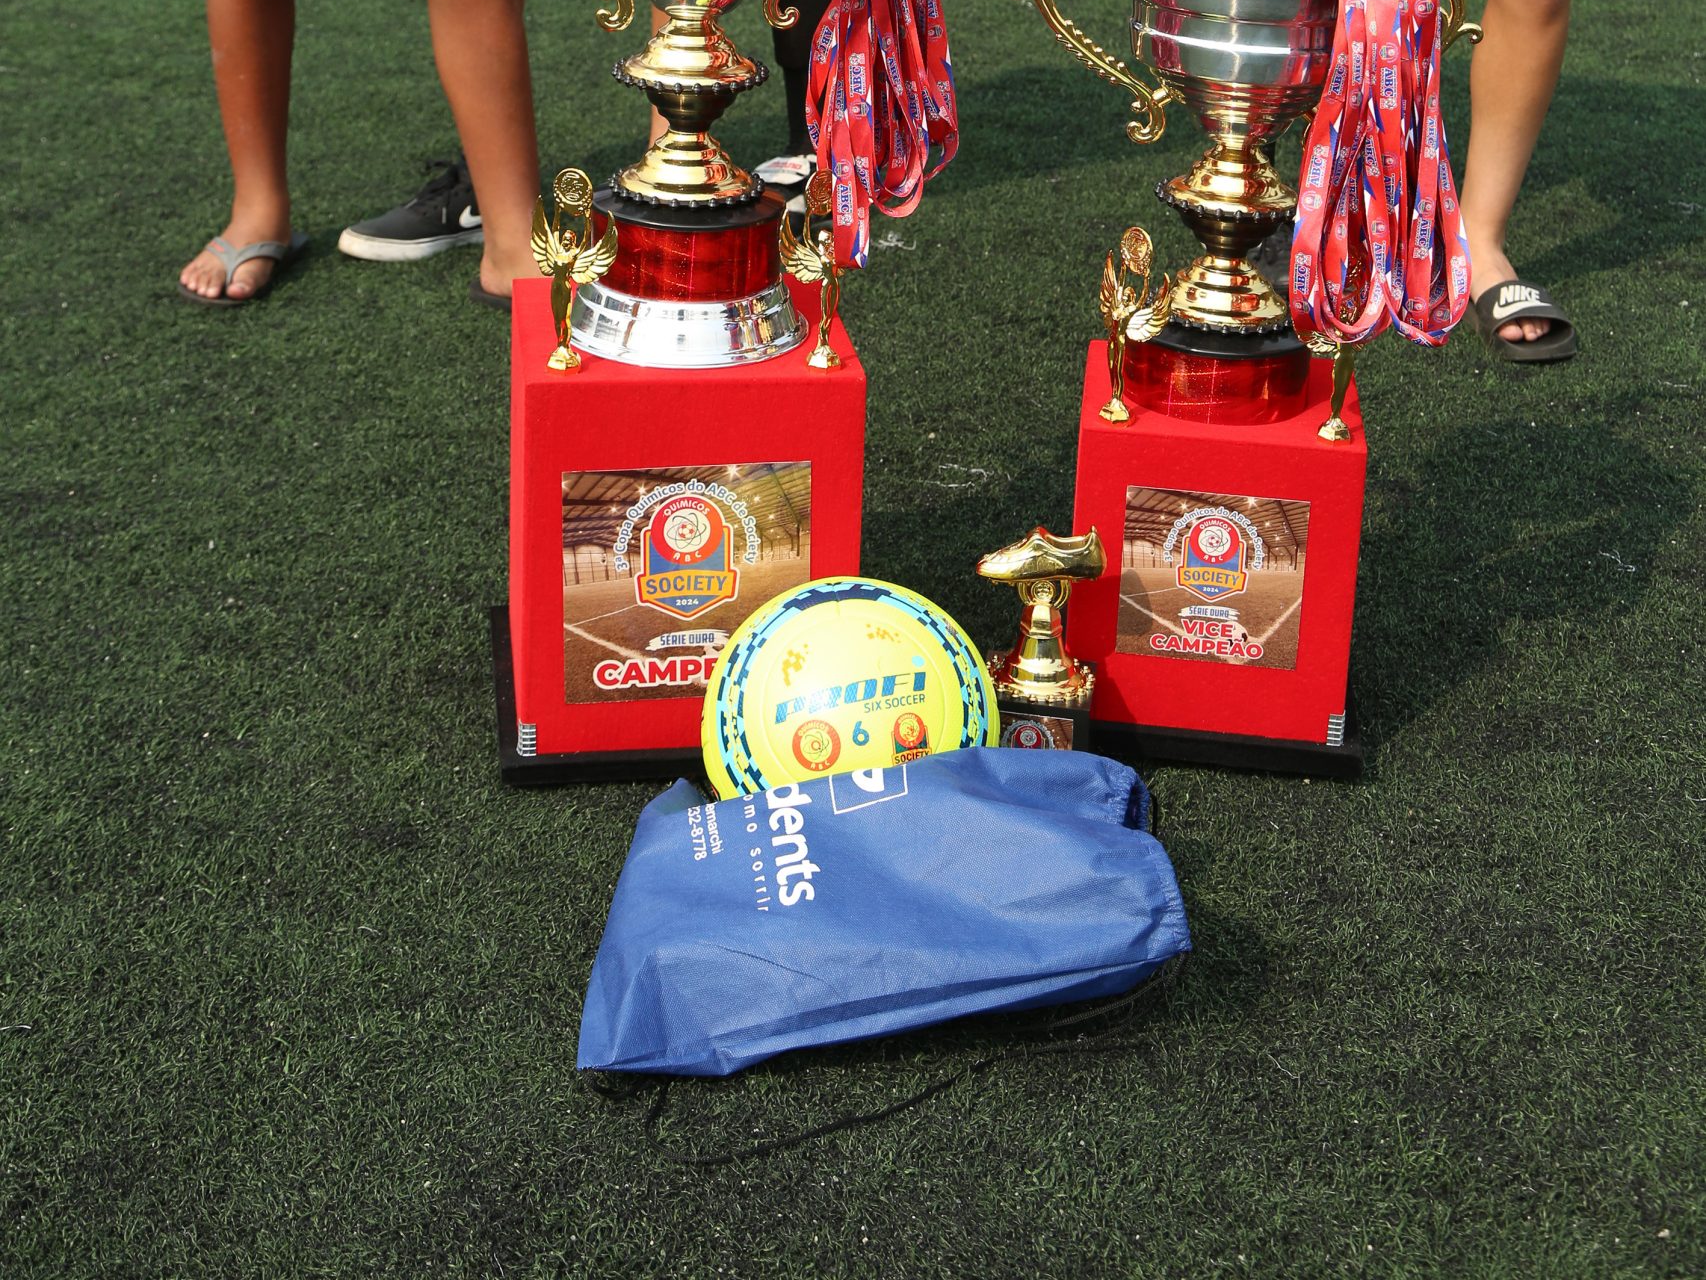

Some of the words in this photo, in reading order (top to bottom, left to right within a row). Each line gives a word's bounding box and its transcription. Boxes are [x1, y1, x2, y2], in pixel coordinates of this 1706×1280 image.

[852, 66, 863, 95] ABC
[1385, 68, 1394, 97] ABC
[1311, 157, 1323, 187] ABC
[841, 184, 849, 213] ABC
[1419, 219, 1428, 246] ABC
[1297, 265, 1307, 293] ABC
[1499, 284, 1541, 306] NIKE
[616, 521, 631, 552] Copa
[628, 484, 684, 519] Químicos
[688, 480, 704, 492] do
[708, 483, 734, 504] ABC
[733, 501, 747, 518] de
[743, 516, 761, 564] Society
[1164, 528, 1181, 551] Copa
[1217, 506, 1229, 516] do
[1231, 511, 1249, 528] ABC
[1248, 525, 1257, 538] de
[1253, 536, 1264, 570] Society
[646, 575, 728, 595] SOCIETY
[1183, 570, 1240, 586] SOCIETY
[676, 598, 699, 606] 2024
[1188, 605, 1208, 617] SÉRIE
[660, 632, 686, 646] SÉRIE
[688, 633, 715, 644] OURO
[1182, 619, 1234, 638] VICE
[1151, 634, 1263, 659] CAMPEÃO
[864, 700, 882, 713] SIX
[885, 693, 926, 709] SOCCER
[852, 720, 870, 746] 6
[894, 750, 930, 765] SOCIETY
[704, 801, 724, 855] emarchi
[750, 847, 771, 912] sorrir
